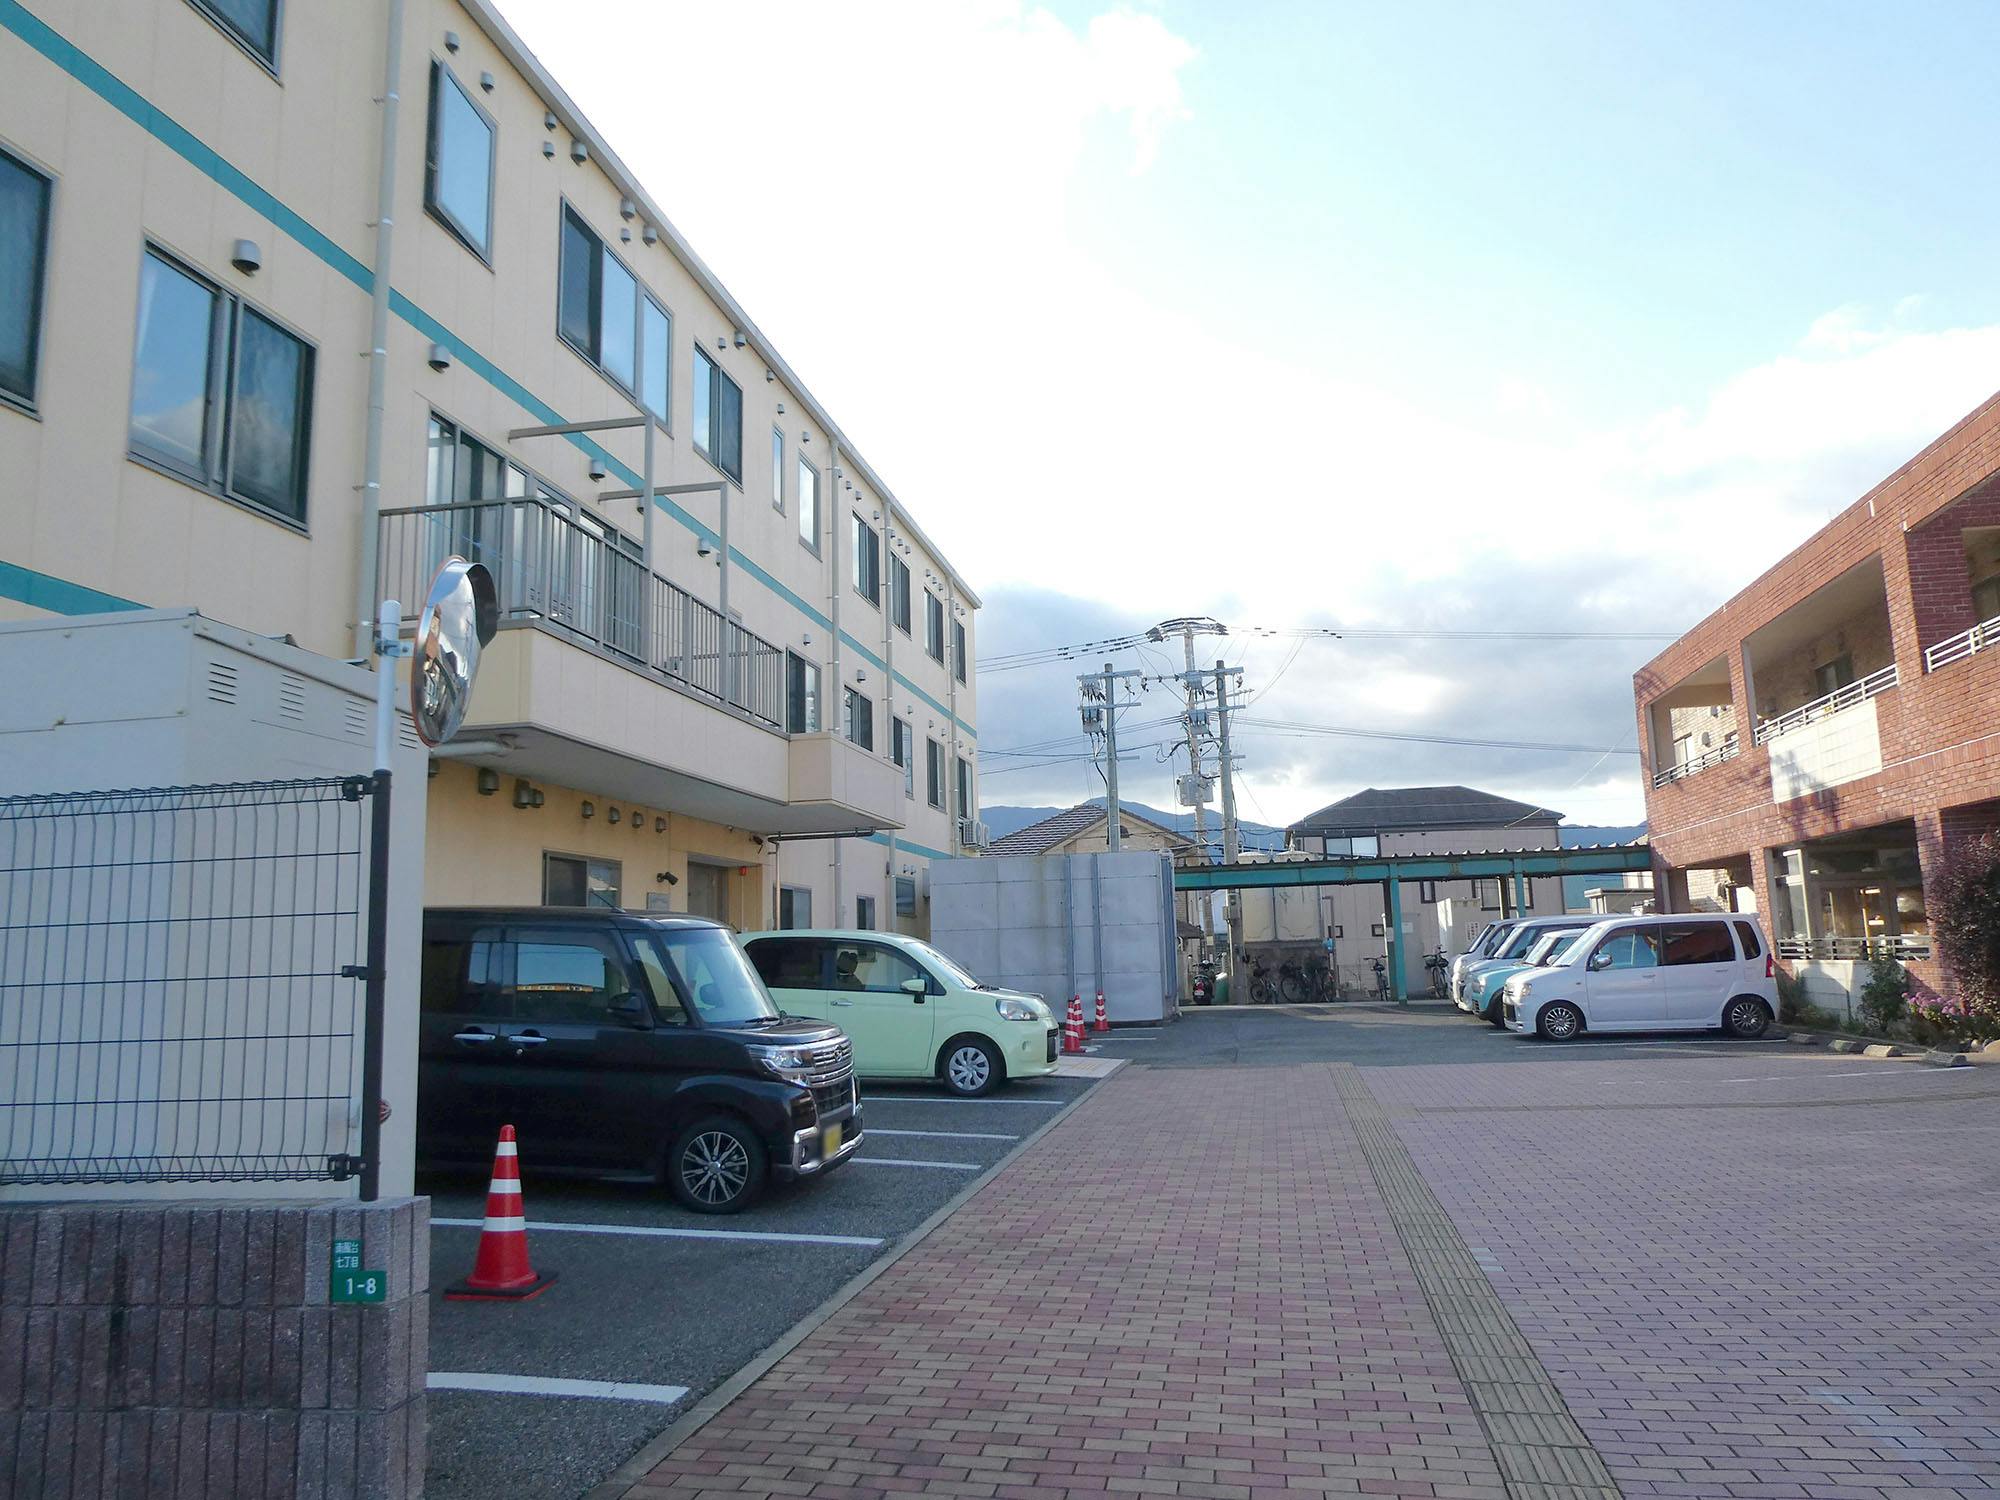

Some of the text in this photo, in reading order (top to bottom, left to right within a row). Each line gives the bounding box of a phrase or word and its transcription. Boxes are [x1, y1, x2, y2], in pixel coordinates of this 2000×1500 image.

[335, 1256, 359, 1268] 七丁目
[346, 1277, 376, 1295] 1-8
